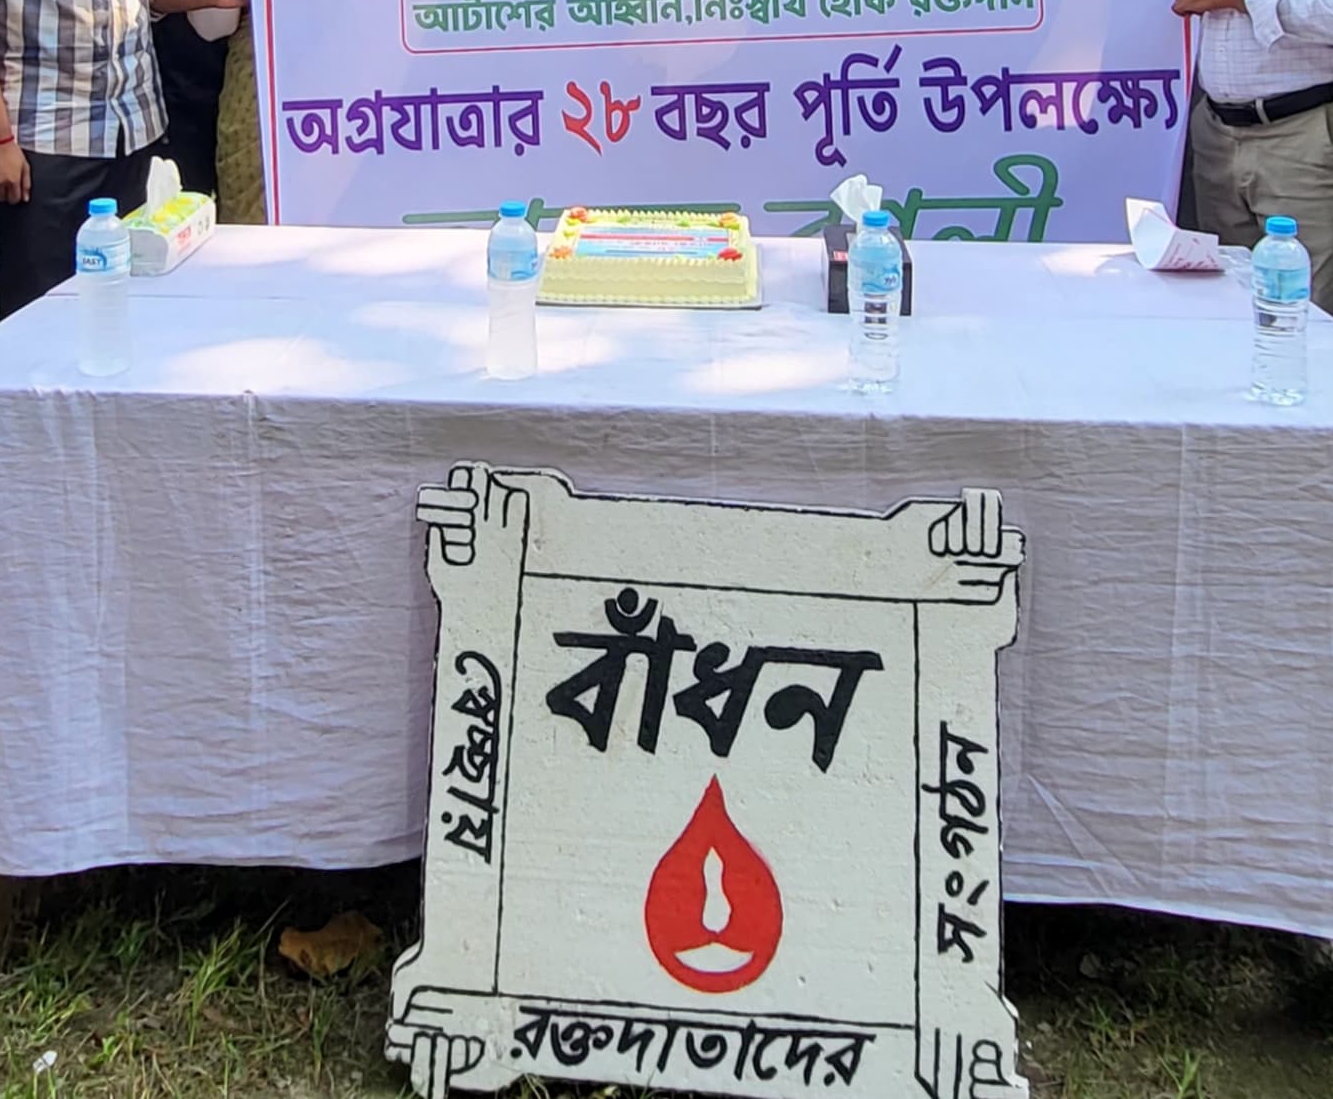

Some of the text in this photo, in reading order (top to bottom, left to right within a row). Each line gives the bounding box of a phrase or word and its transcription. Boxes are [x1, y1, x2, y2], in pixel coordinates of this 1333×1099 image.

[282, 44, 1180, 168] অগ্রযাত্রার ২৮ বছর পূর্তি উপলক্ষ্যে
[546, 587, 884, 773] বাঁধন
[922, 721, 989, 963] সংগঠন
[510, 1007, 876, 1085] রক্তদাতাদের
